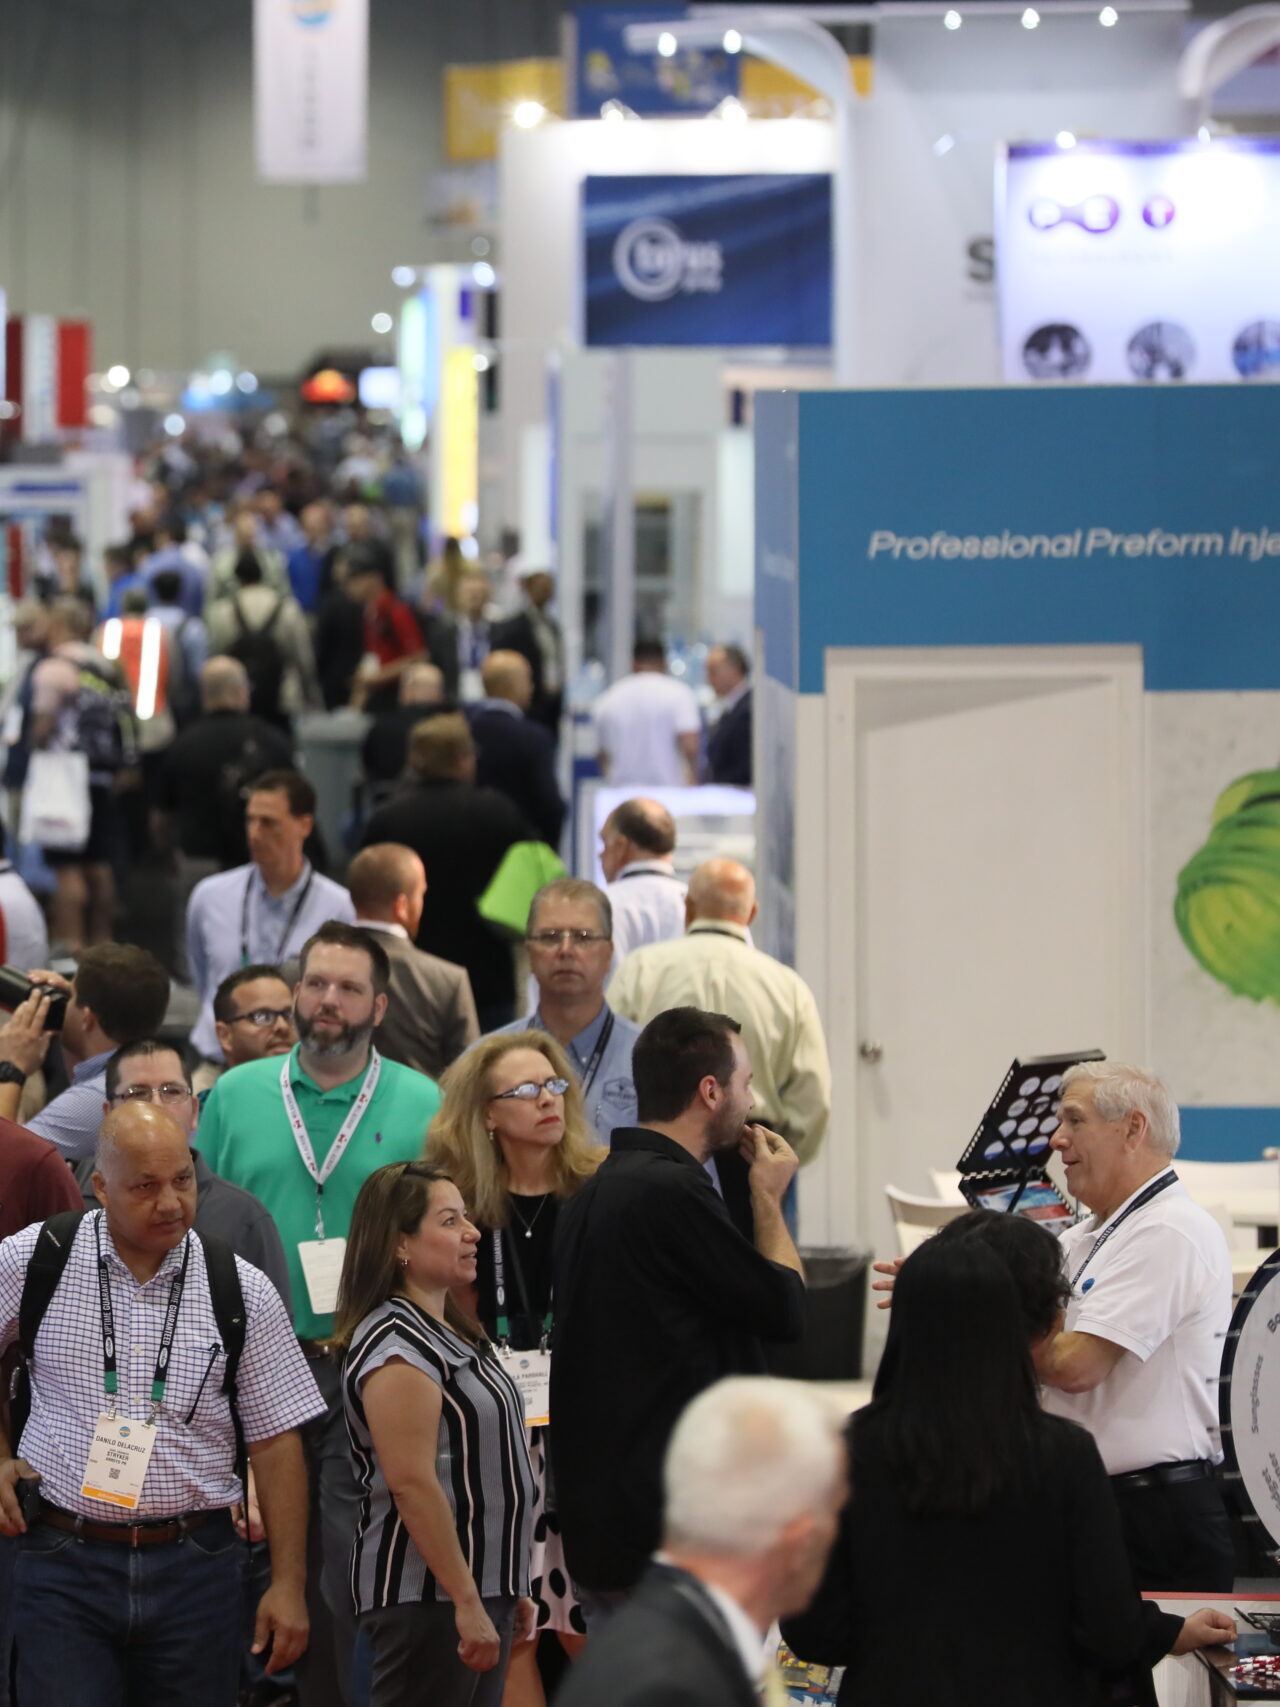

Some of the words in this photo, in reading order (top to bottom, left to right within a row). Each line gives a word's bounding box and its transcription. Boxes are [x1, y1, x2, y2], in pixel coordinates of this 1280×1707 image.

[868, 529, 1082, 560] Professional
[1085, 527, 1222, 557] Preform
[100, 1268, 110, 1311] GUARANTEED
[102, 1312, 112, 1335] UPTIME
[163, 1304, 178, 1346] GUARANTEED
[1250, 1354, 1264, 1434] Sunglasses
[96, 1435, 116, 1446] DANILO
[117, 1441, 146, 1454] DELACRUZ
